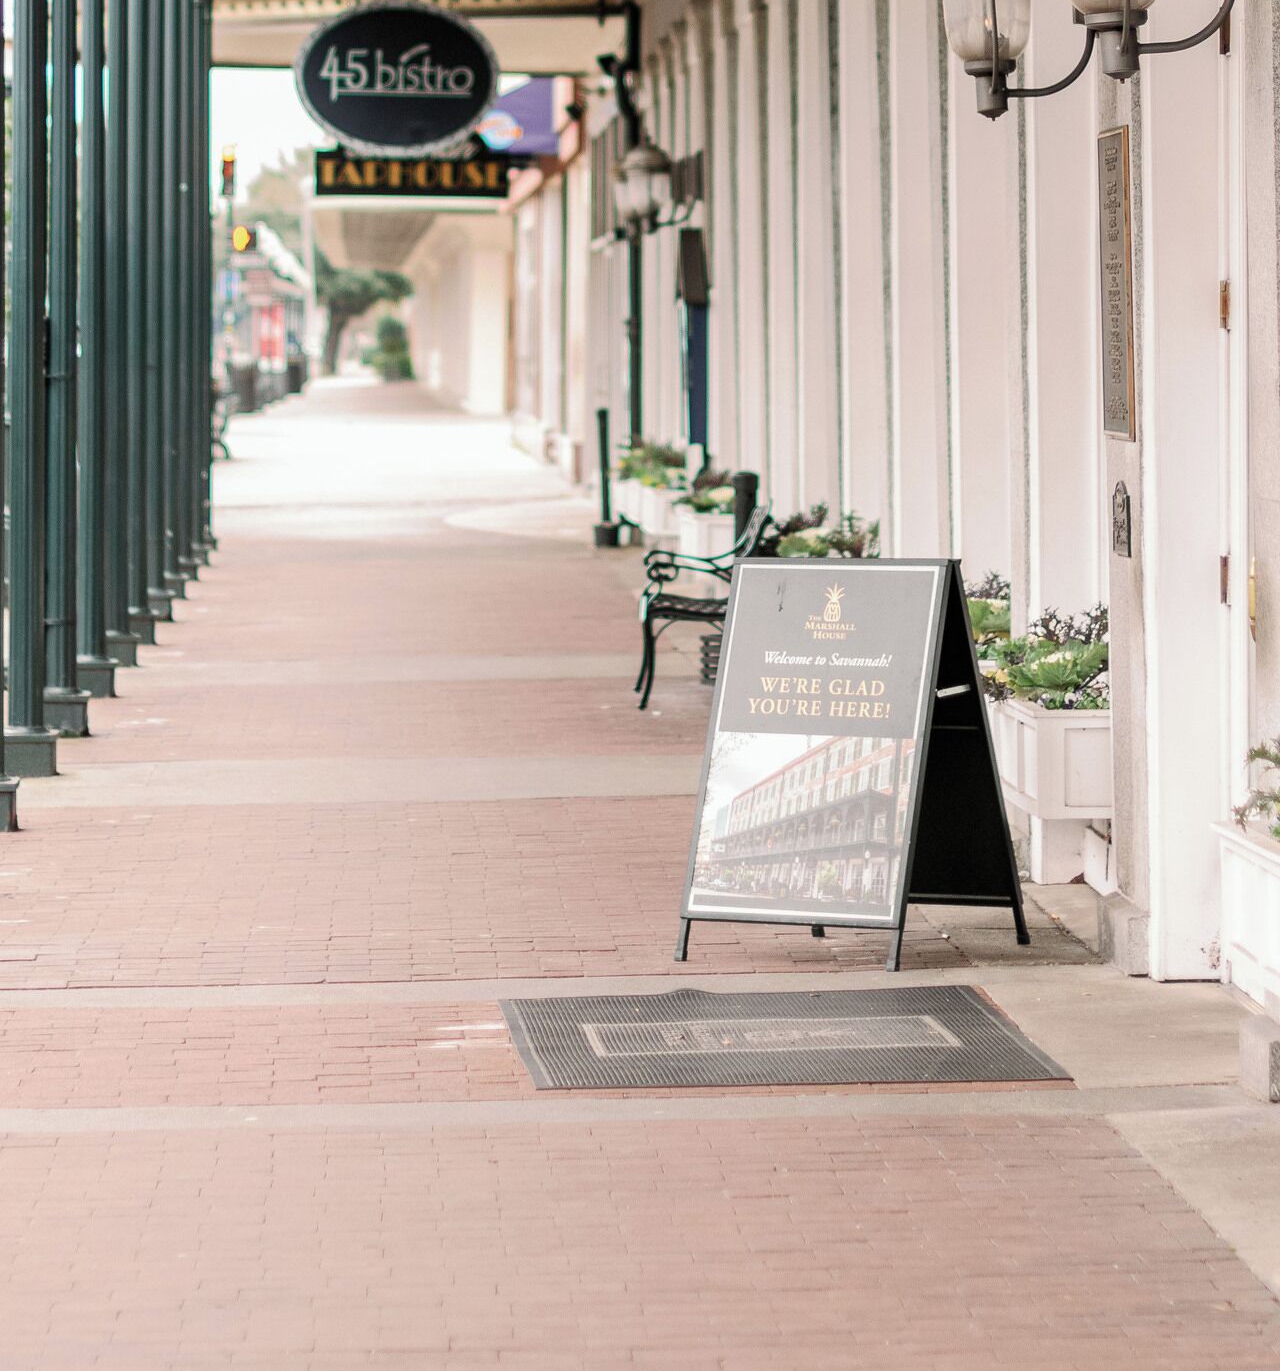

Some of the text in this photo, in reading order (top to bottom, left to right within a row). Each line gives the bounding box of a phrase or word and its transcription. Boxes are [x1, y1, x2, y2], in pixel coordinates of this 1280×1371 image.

[320, 43, 475, 102] 45 bistro
[804, 621, 857, 631] MARSHALL
[812, 631, 847, 640] HOUSE
[764, 651, 893, 667] Welcome to Savannah!
[760, 676, 885, 696] WE'RE GLAD
[748, 697, 891, 718] YOU'RE HERE!
